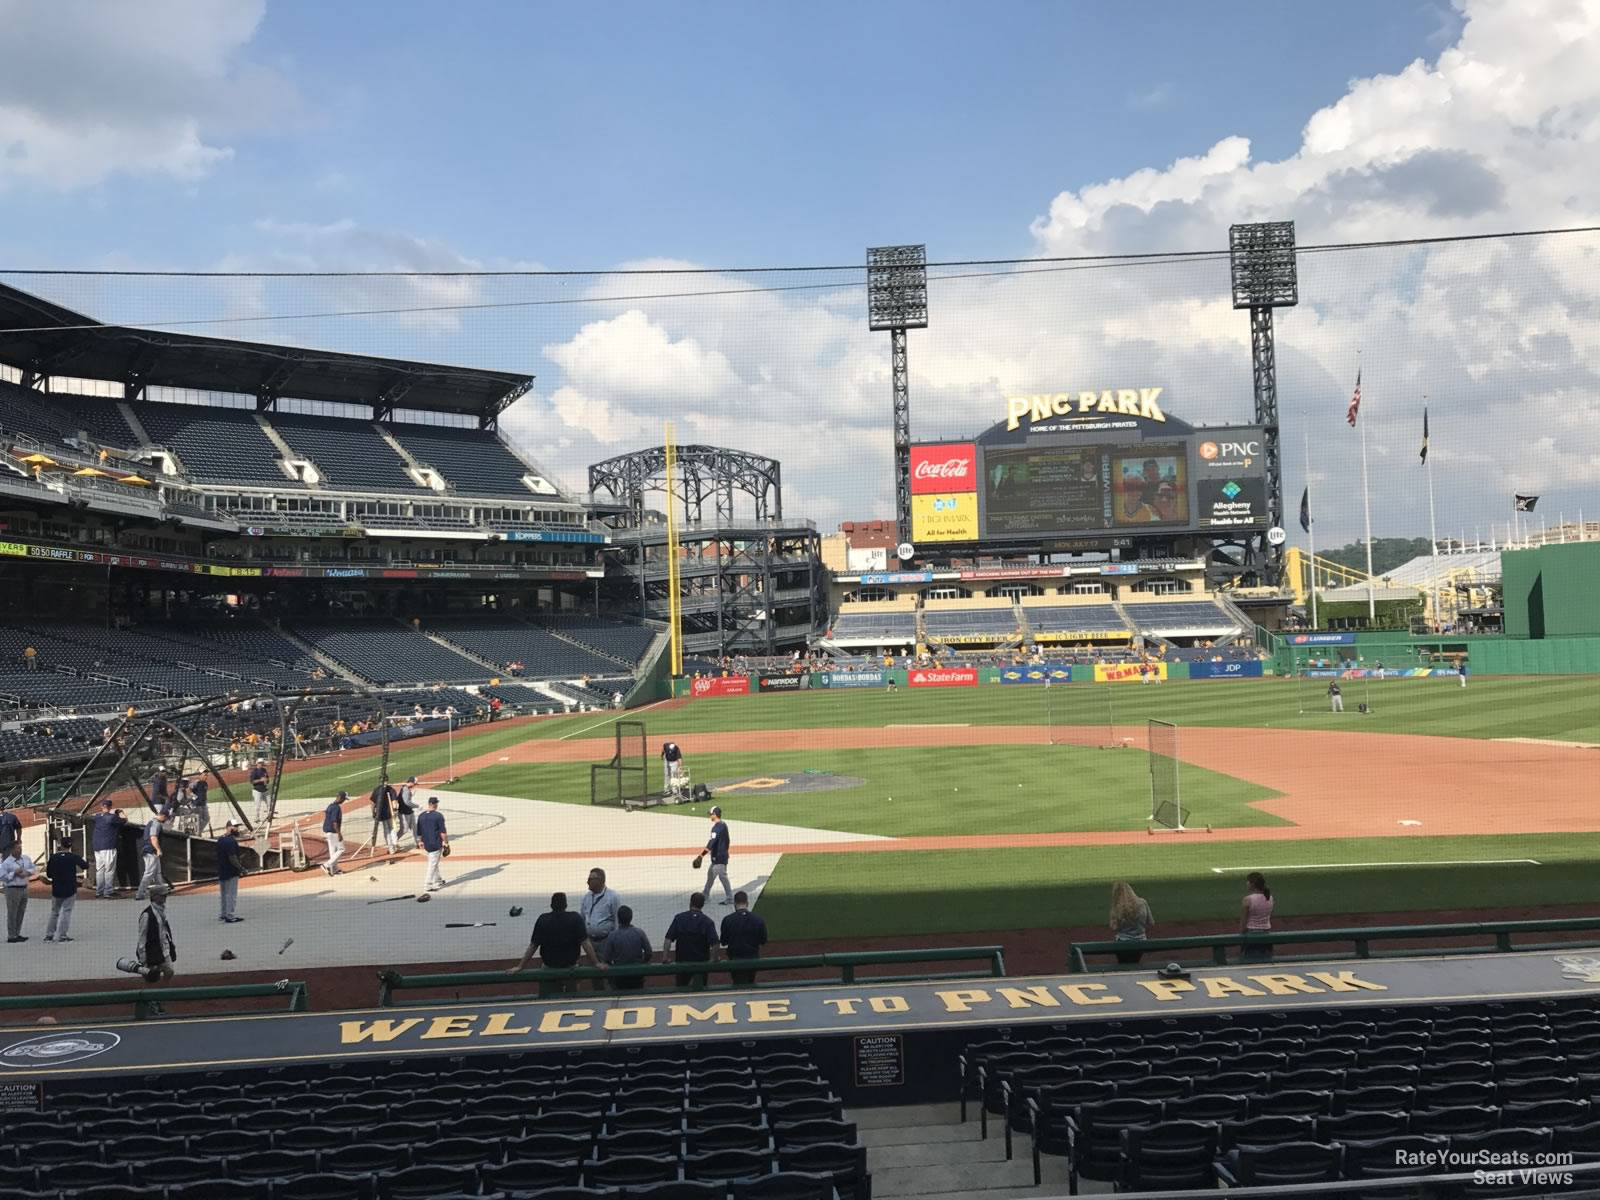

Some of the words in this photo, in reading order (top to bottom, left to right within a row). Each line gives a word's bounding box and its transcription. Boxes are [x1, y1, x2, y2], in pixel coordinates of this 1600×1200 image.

[1007, 393, 1072, 432] PNC
[1078, 387, 1166, 423] PARK
[1221, 442, 1260, 456] PNC
[915, 459, 969, 479] Coca-Cola
[1102, 455, 1112, 517] BREWERS
[1213, 502, 1251, 510] Allegheny
[946, 527, 967, 535] Health
[515, 532, 542, 540] KOPPERS
[1270, 531, 1284, 540] Lite
[1071, 540, 1088, 548] JULY
[51, 550, 73, 559] RAFFLE
[900, 546, 913, 555] Lite
[84, 553, 93, 561] FOR
[872, 551, 883, 559] Lite
[858, 673, 881, 681] BORDAS
[338, 999, 797, 1044] WELCOME
[823, 997, 911, 1015] TO
[935, 982, 1124, 1012] PNC
[1135, 971, 1389, 1001] PARK
[0, 1084, 36, 1092] CAUTION
